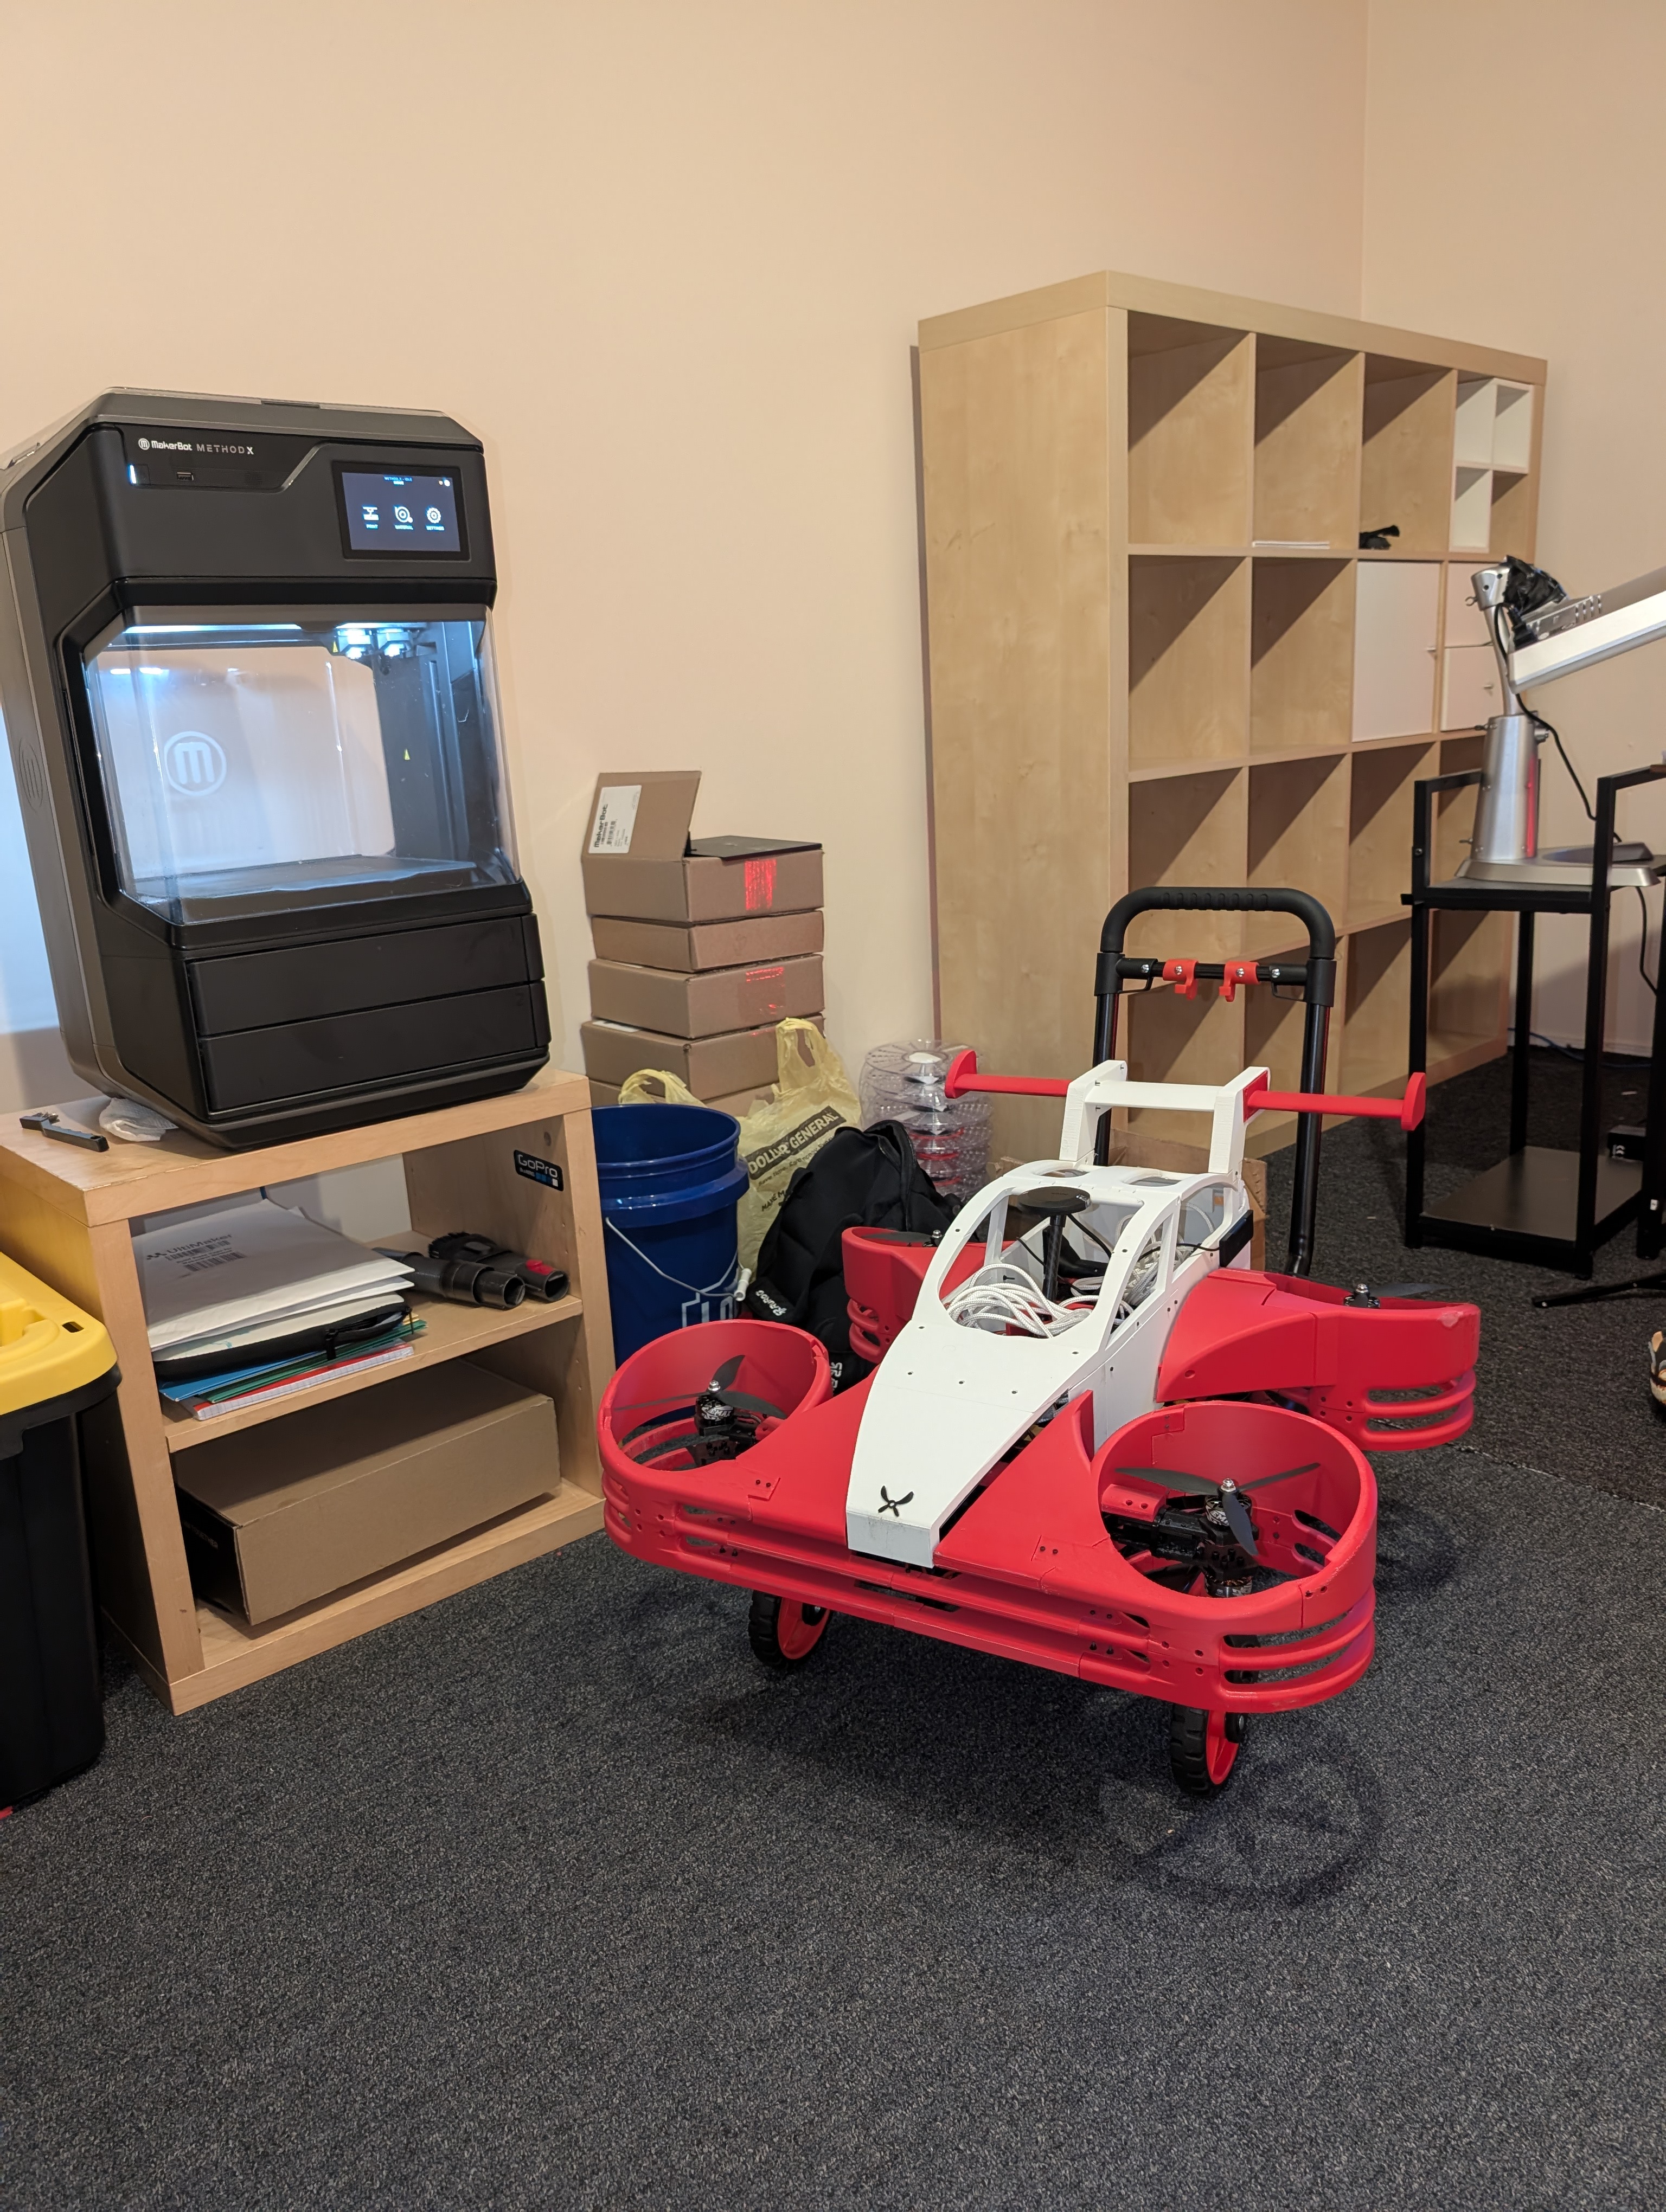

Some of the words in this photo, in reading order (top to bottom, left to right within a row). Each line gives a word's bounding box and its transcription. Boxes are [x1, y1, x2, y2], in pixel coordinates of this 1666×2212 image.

[151, 440, 193, 451] MakerBot
[594, 803, 608, 848] MakerBot
[789, 1113, 840, 1149] GENERAL
[518, 1154, 558, 1178] GoPro
